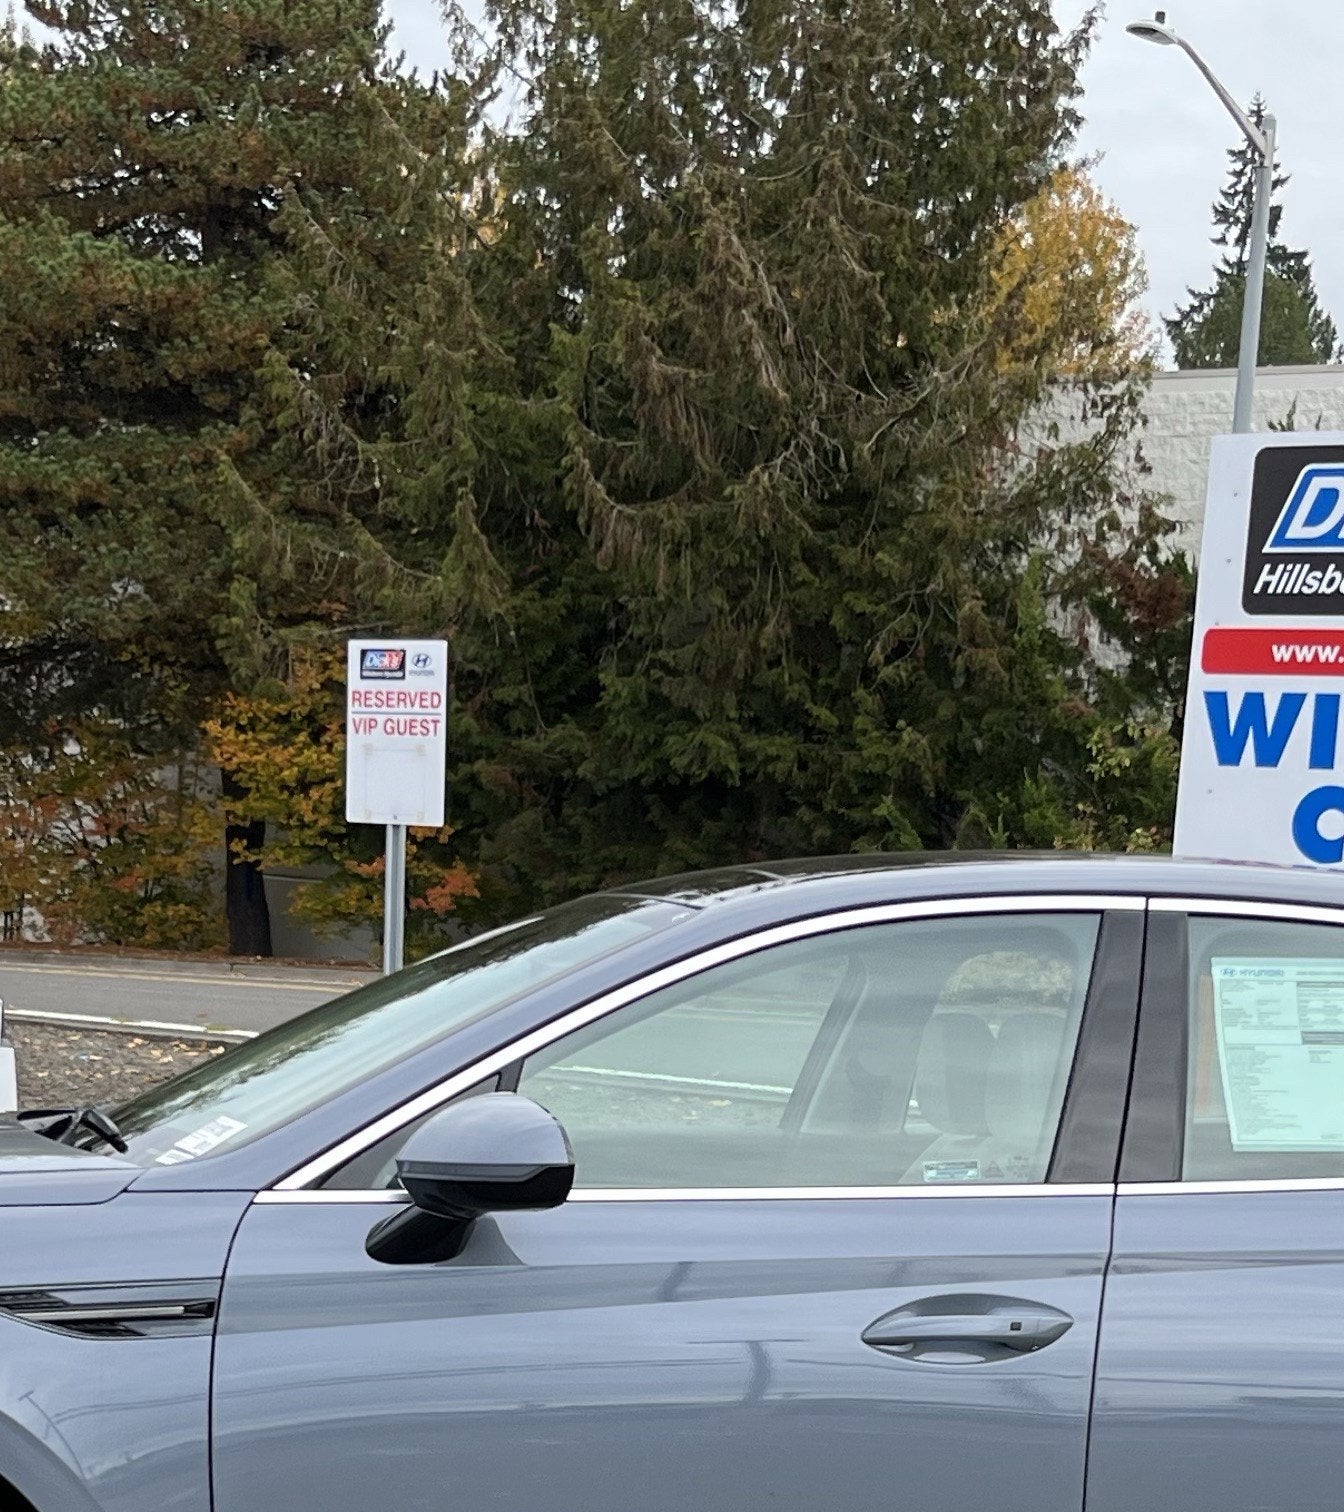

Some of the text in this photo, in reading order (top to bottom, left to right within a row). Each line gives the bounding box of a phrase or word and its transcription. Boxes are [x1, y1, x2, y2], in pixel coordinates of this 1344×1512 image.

[352, 690, 441, 709] RESERVED
[353, 718, 440, 737] VIP GUEST
